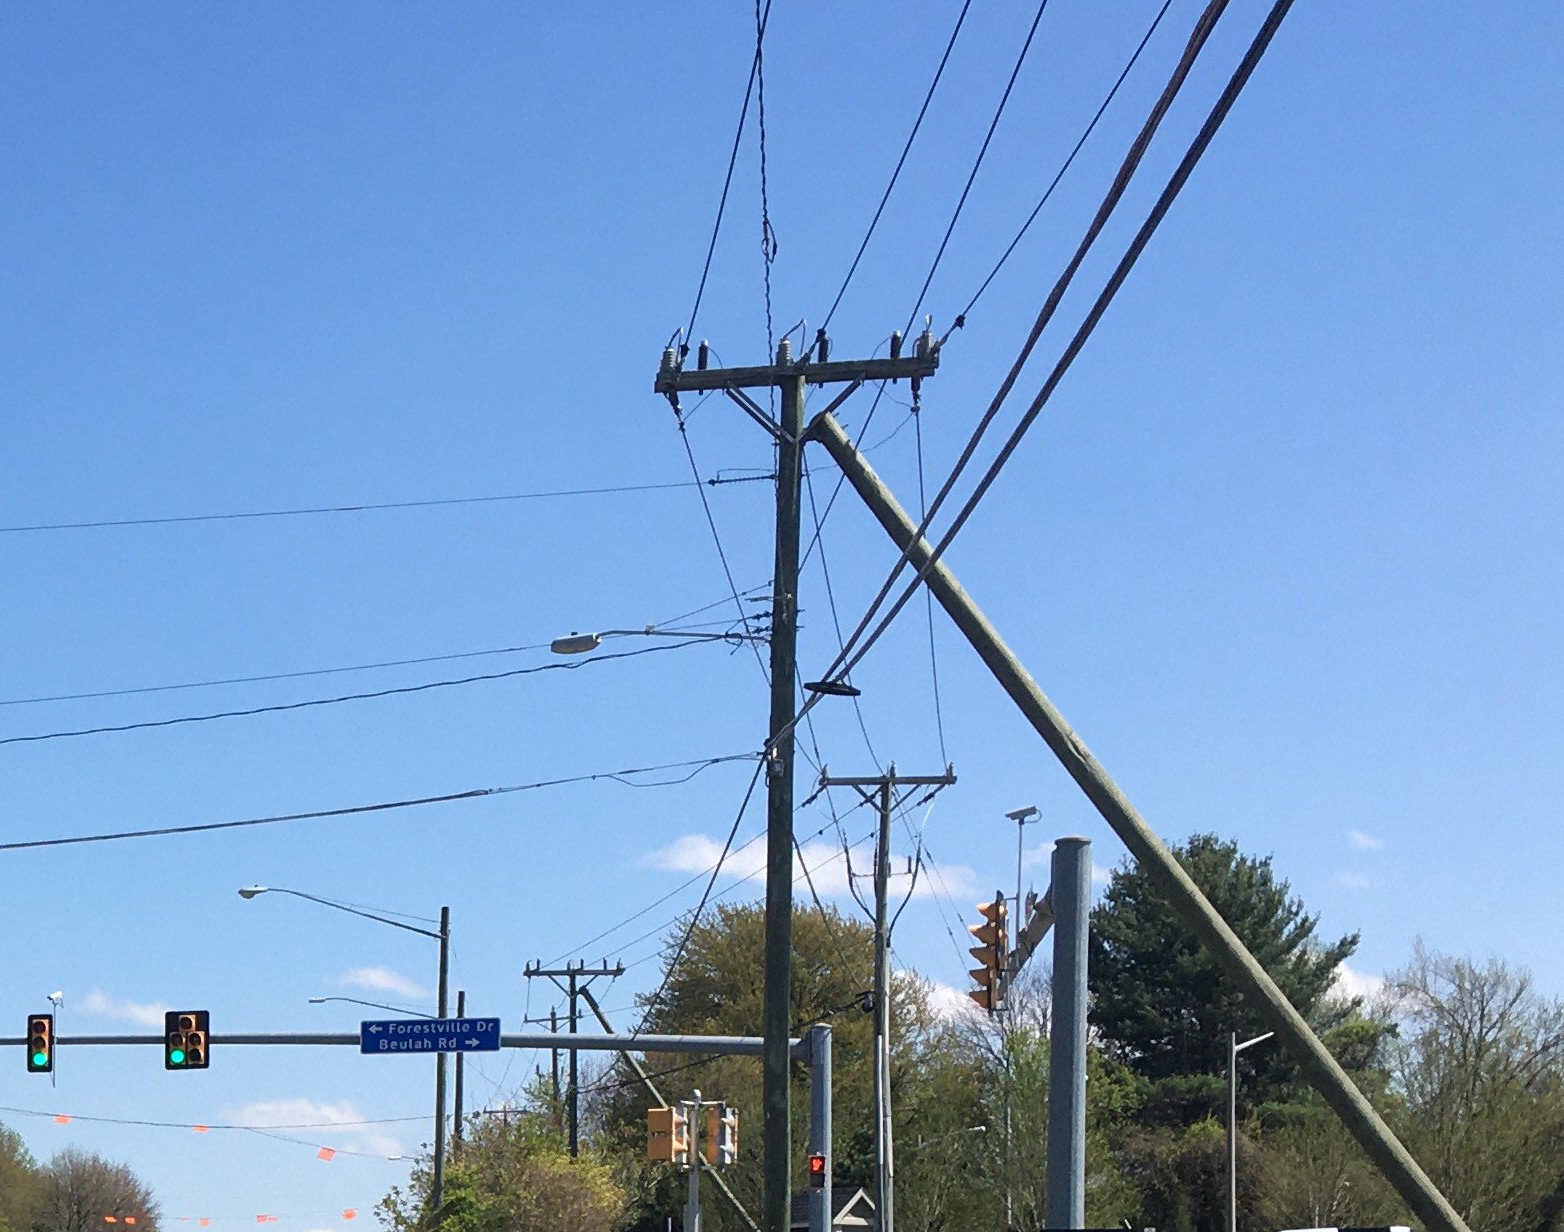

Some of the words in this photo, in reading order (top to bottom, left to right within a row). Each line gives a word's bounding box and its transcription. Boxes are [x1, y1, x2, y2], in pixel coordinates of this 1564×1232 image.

[388, 1021, 470, 1035] Forestville
[476, 1021, 494, 1032] Dr
[379, 1038, 432, 1050] Beulah
[438, 1037, 457, 1049] Rd
